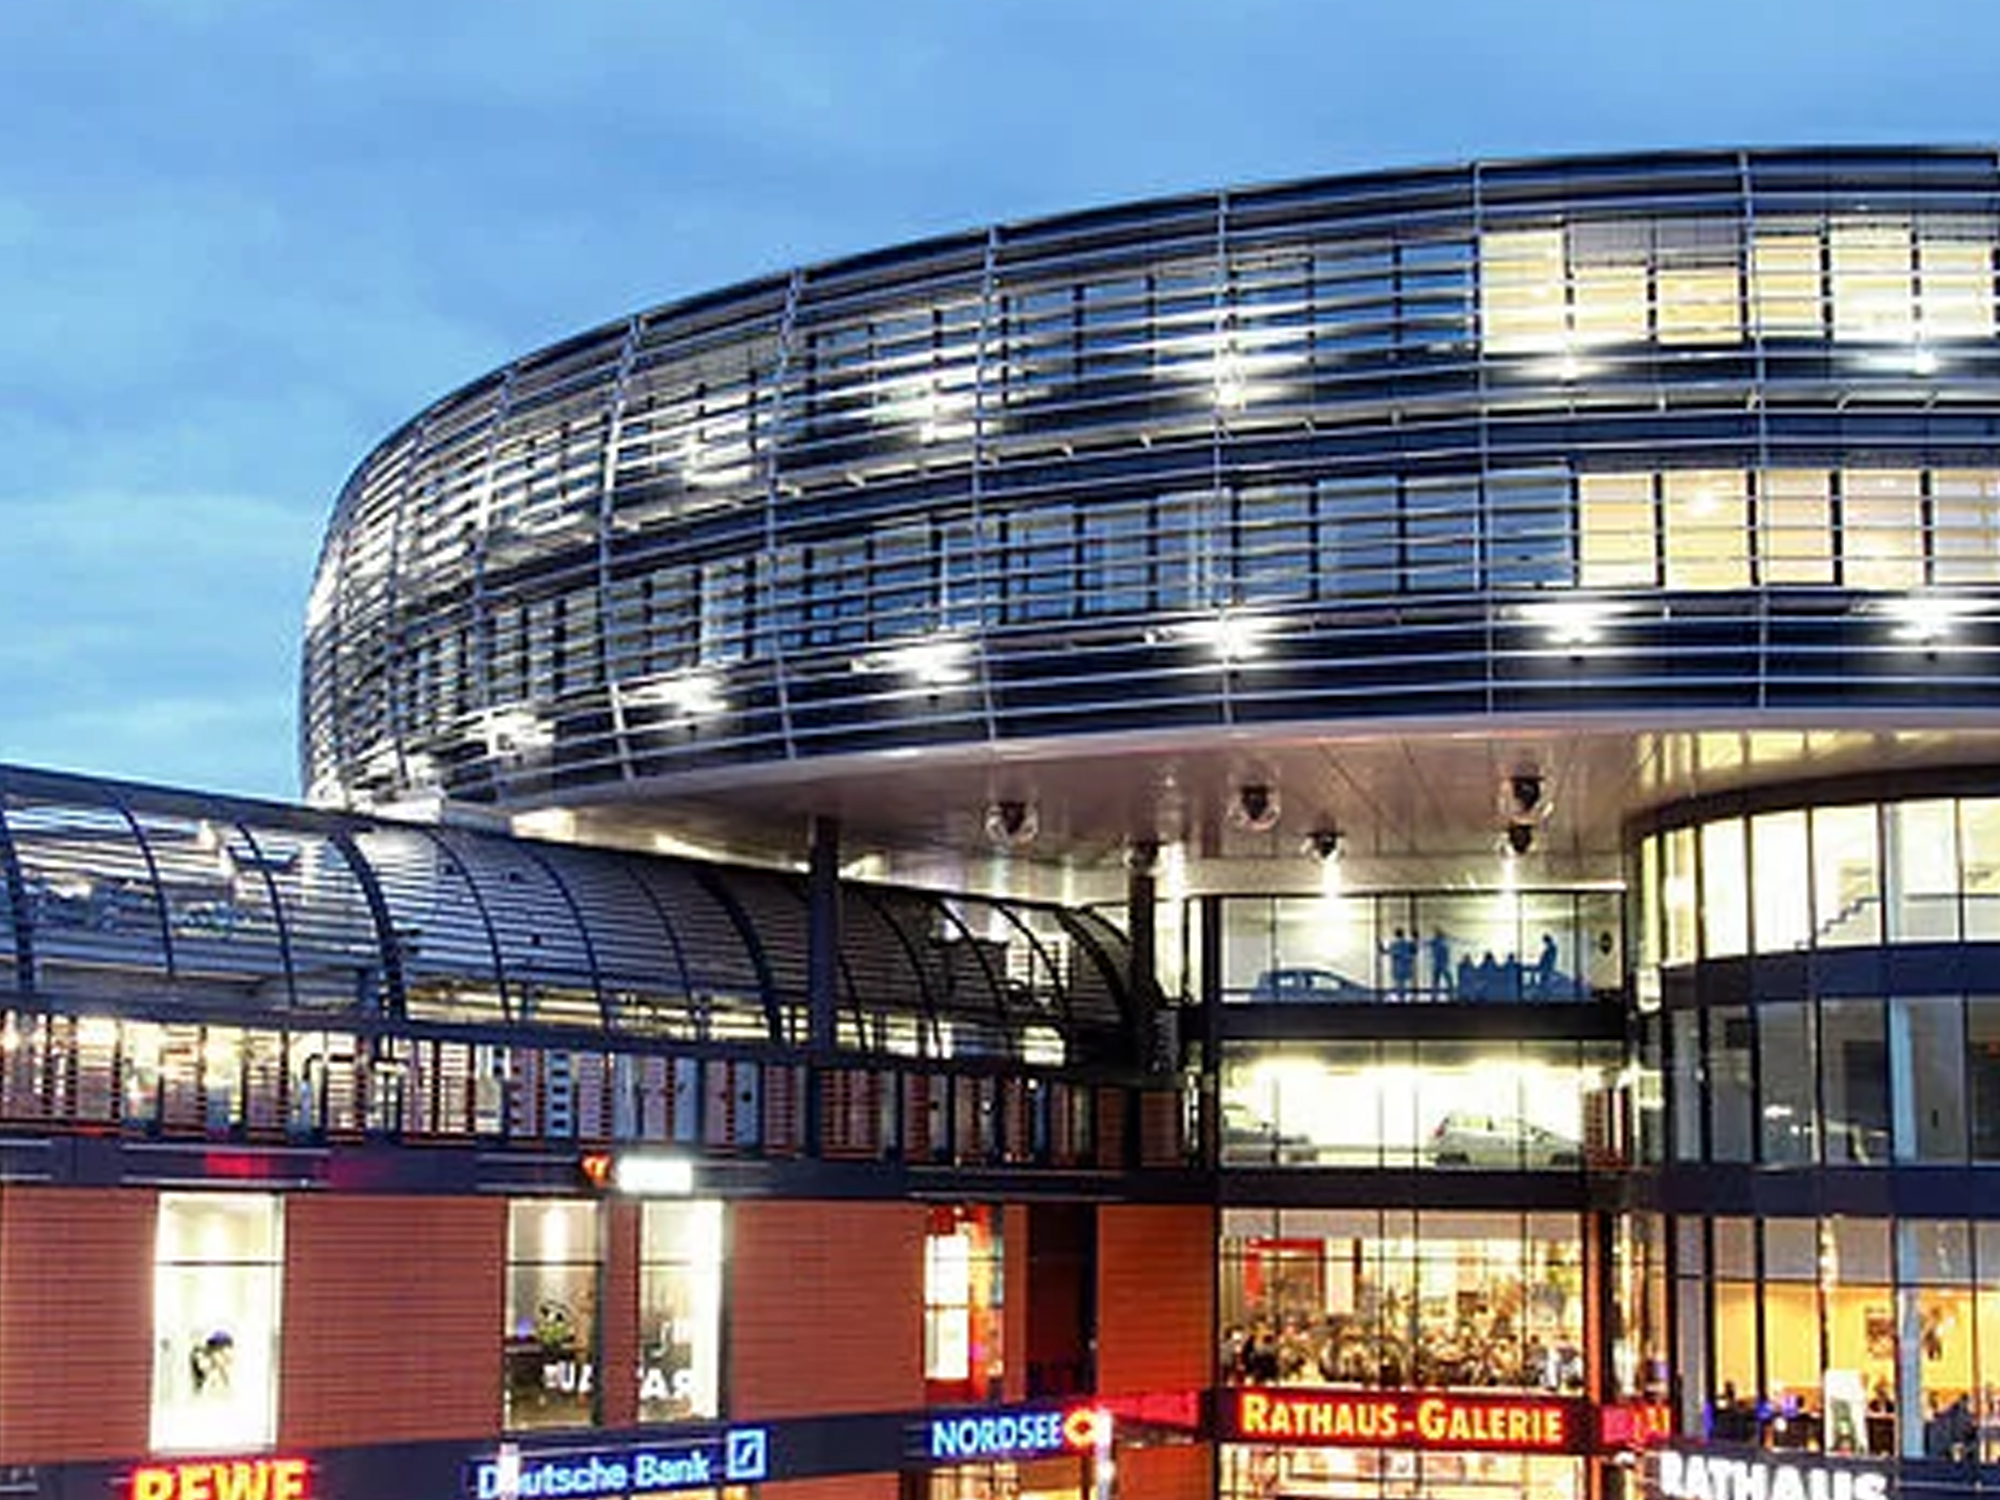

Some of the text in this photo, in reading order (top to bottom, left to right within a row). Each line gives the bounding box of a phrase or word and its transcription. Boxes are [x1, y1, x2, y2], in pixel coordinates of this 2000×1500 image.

[931, 1412, 1063, 1456] NORDSEE
[1241, 1393, 1563, 1443] RATHAUS-GALERIE
[134, 1459, 307, 1500] REWE
[477, 1451, 711, 1500] Dutsche Bank
[1659, 1451, 1888, 1500] RATHAUS
